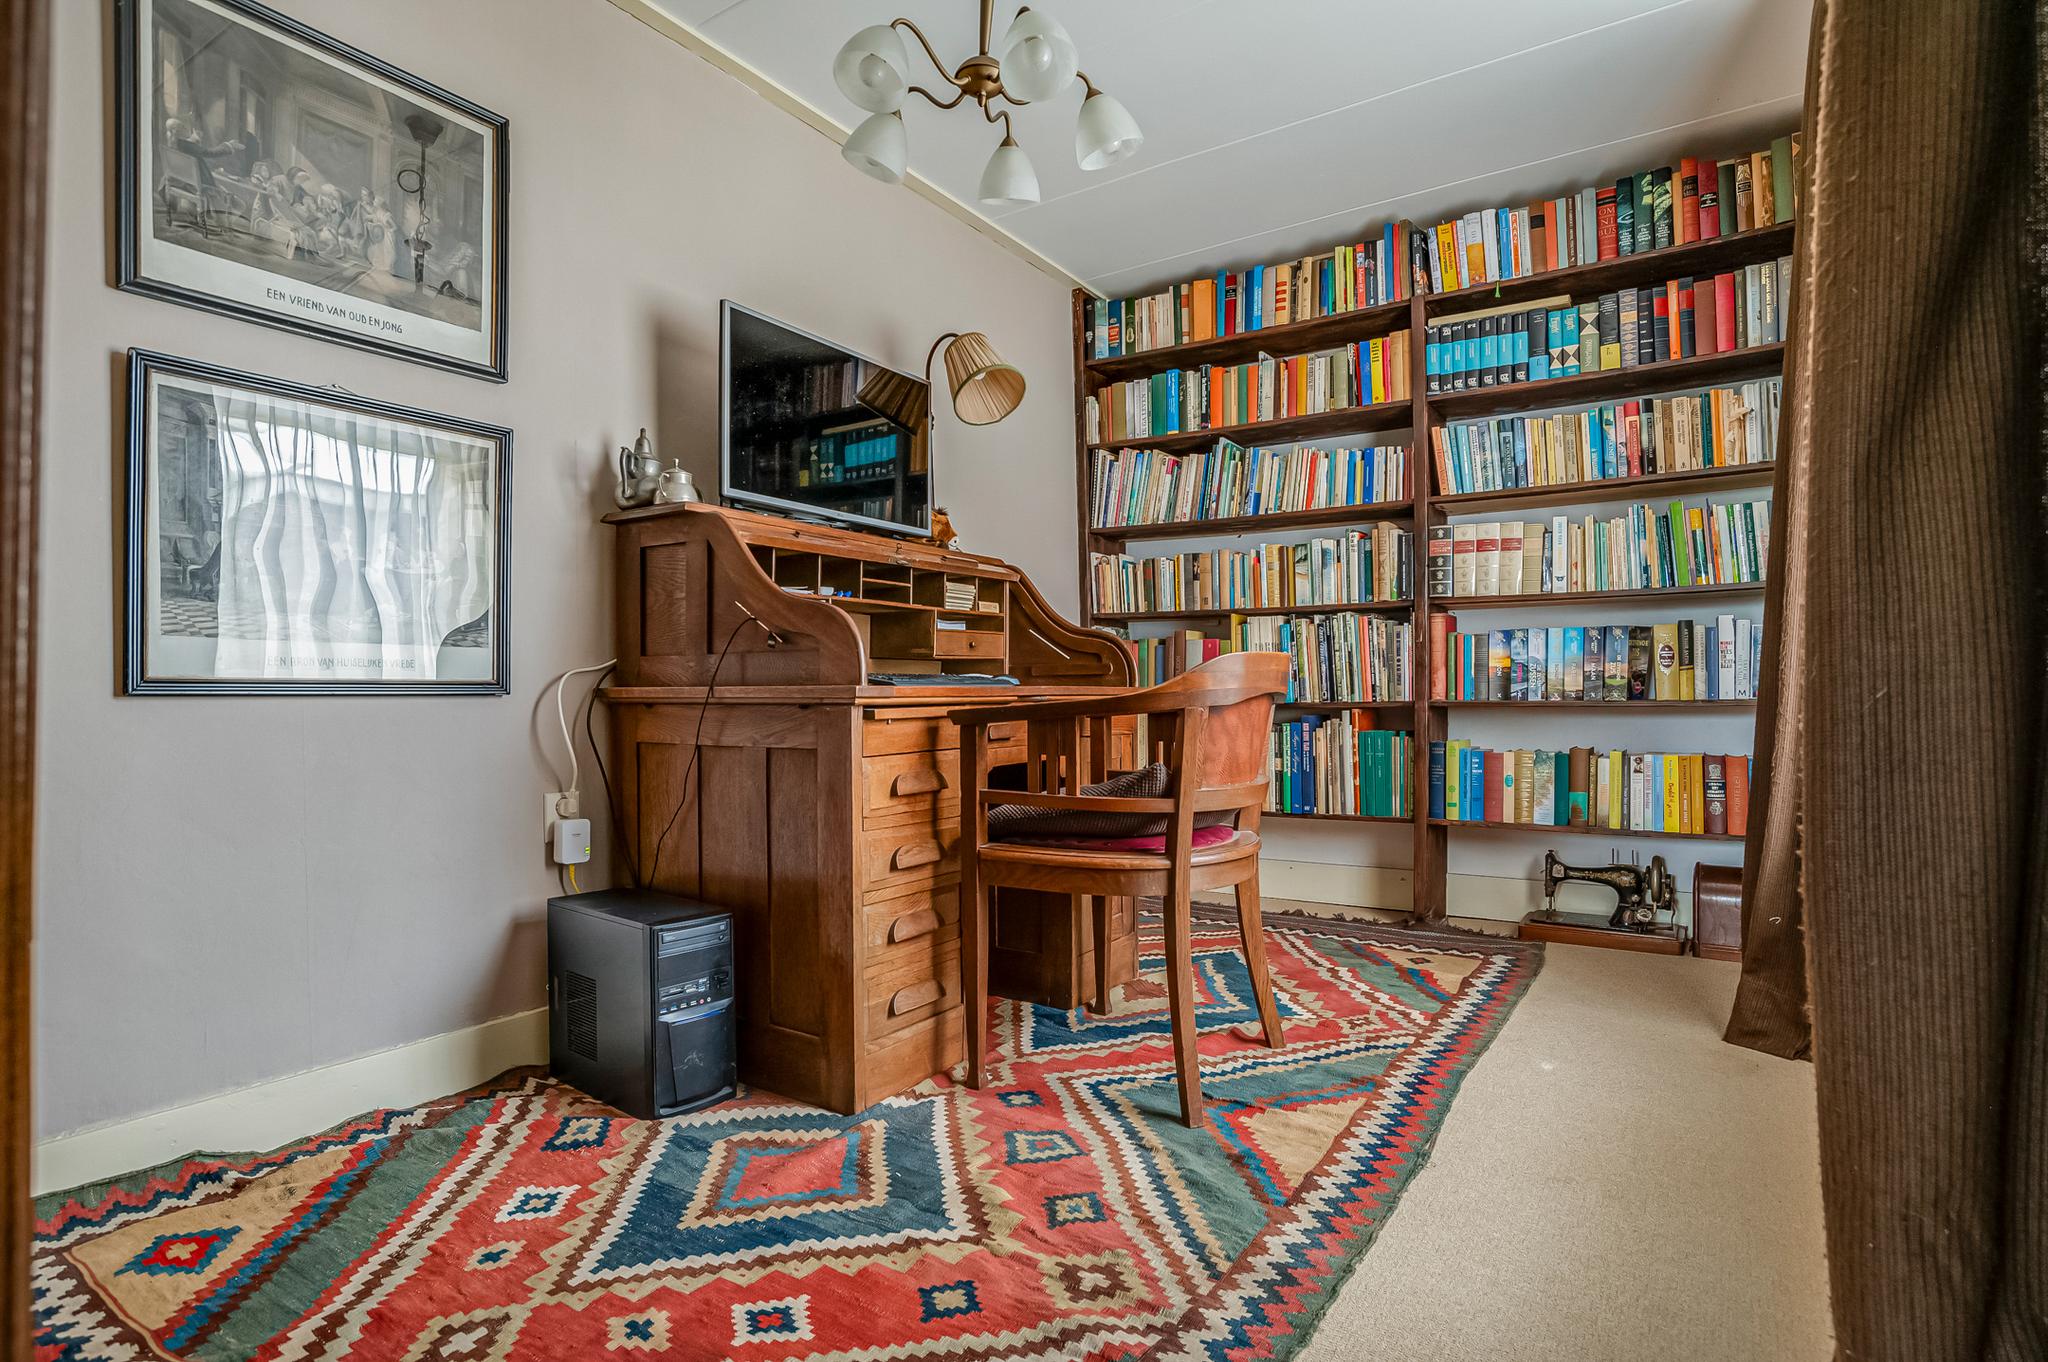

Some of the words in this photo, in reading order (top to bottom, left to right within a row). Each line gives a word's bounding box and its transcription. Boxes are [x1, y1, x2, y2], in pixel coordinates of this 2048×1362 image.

[266, 288, 286, 302] EEN
[289, 294, 325, 313] VRIEND
[326, 303, 347, 318] VAN
[348, 311, 367, 325] OUD
[369, 316, 381, 328] EN
[381, 321, 404, 335] JONG
[317, 656, 335, 669] VAN
[1529, 663, 1537, 688] ZUSSEN
